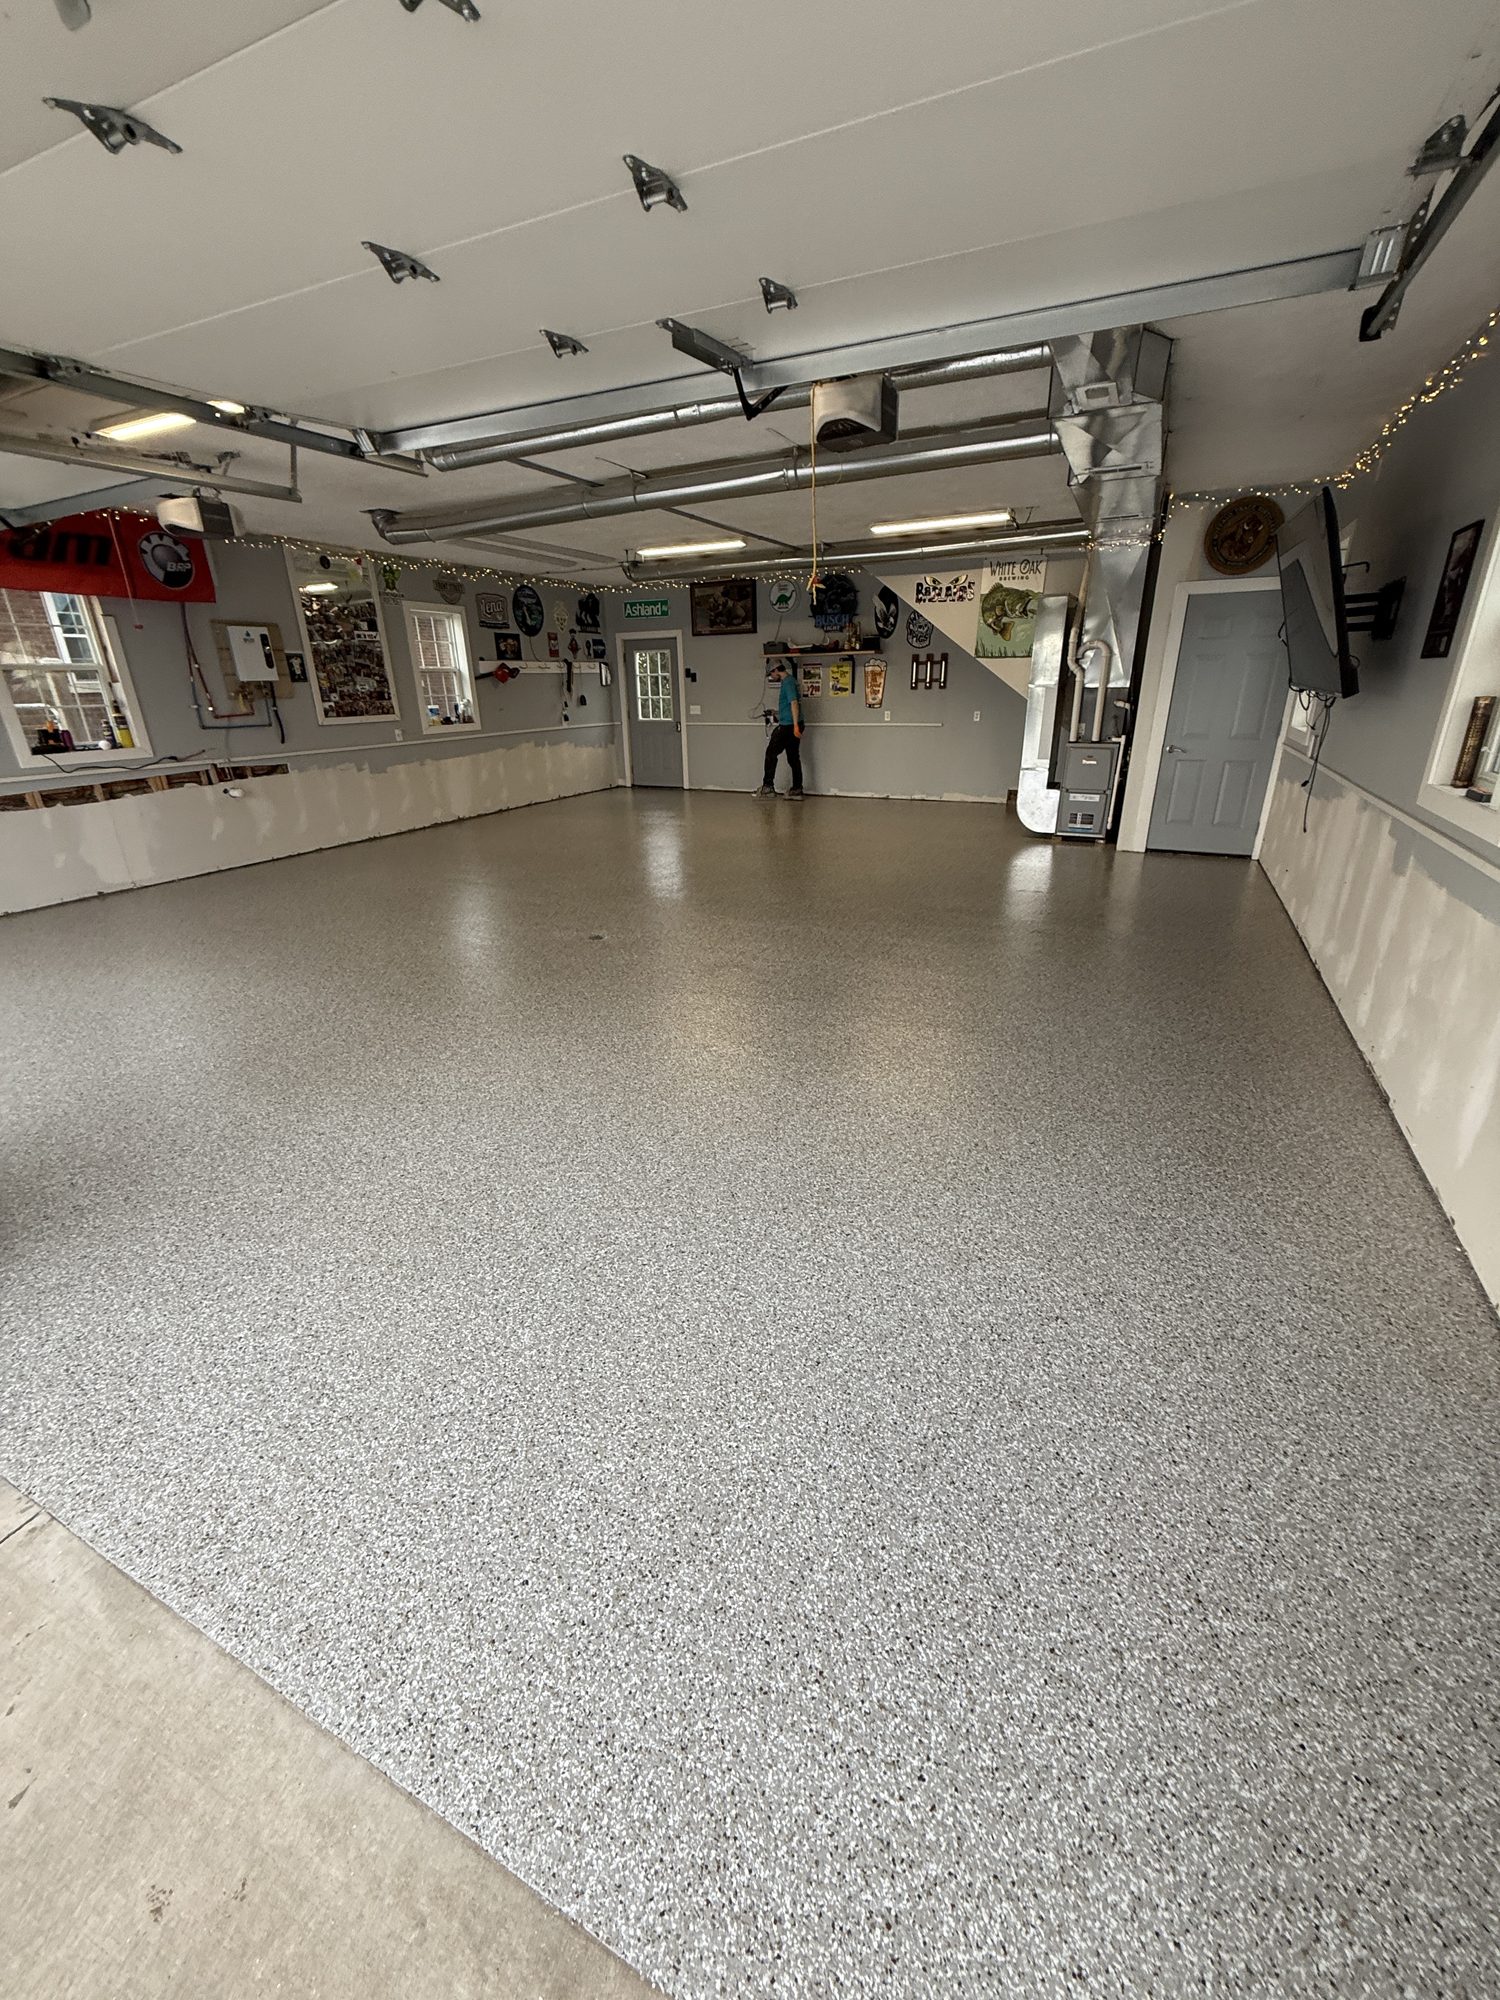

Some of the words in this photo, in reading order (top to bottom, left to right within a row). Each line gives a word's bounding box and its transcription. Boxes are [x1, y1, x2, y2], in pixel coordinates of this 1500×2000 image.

[166, 561, 191, 573] BRP
[990, 561, 1016, 576] WHITE
[1020, 559, 1043, 574] OAK
[625, 602, 661, 617] Ashland
[815, 614, 850, 626] BUSCH
